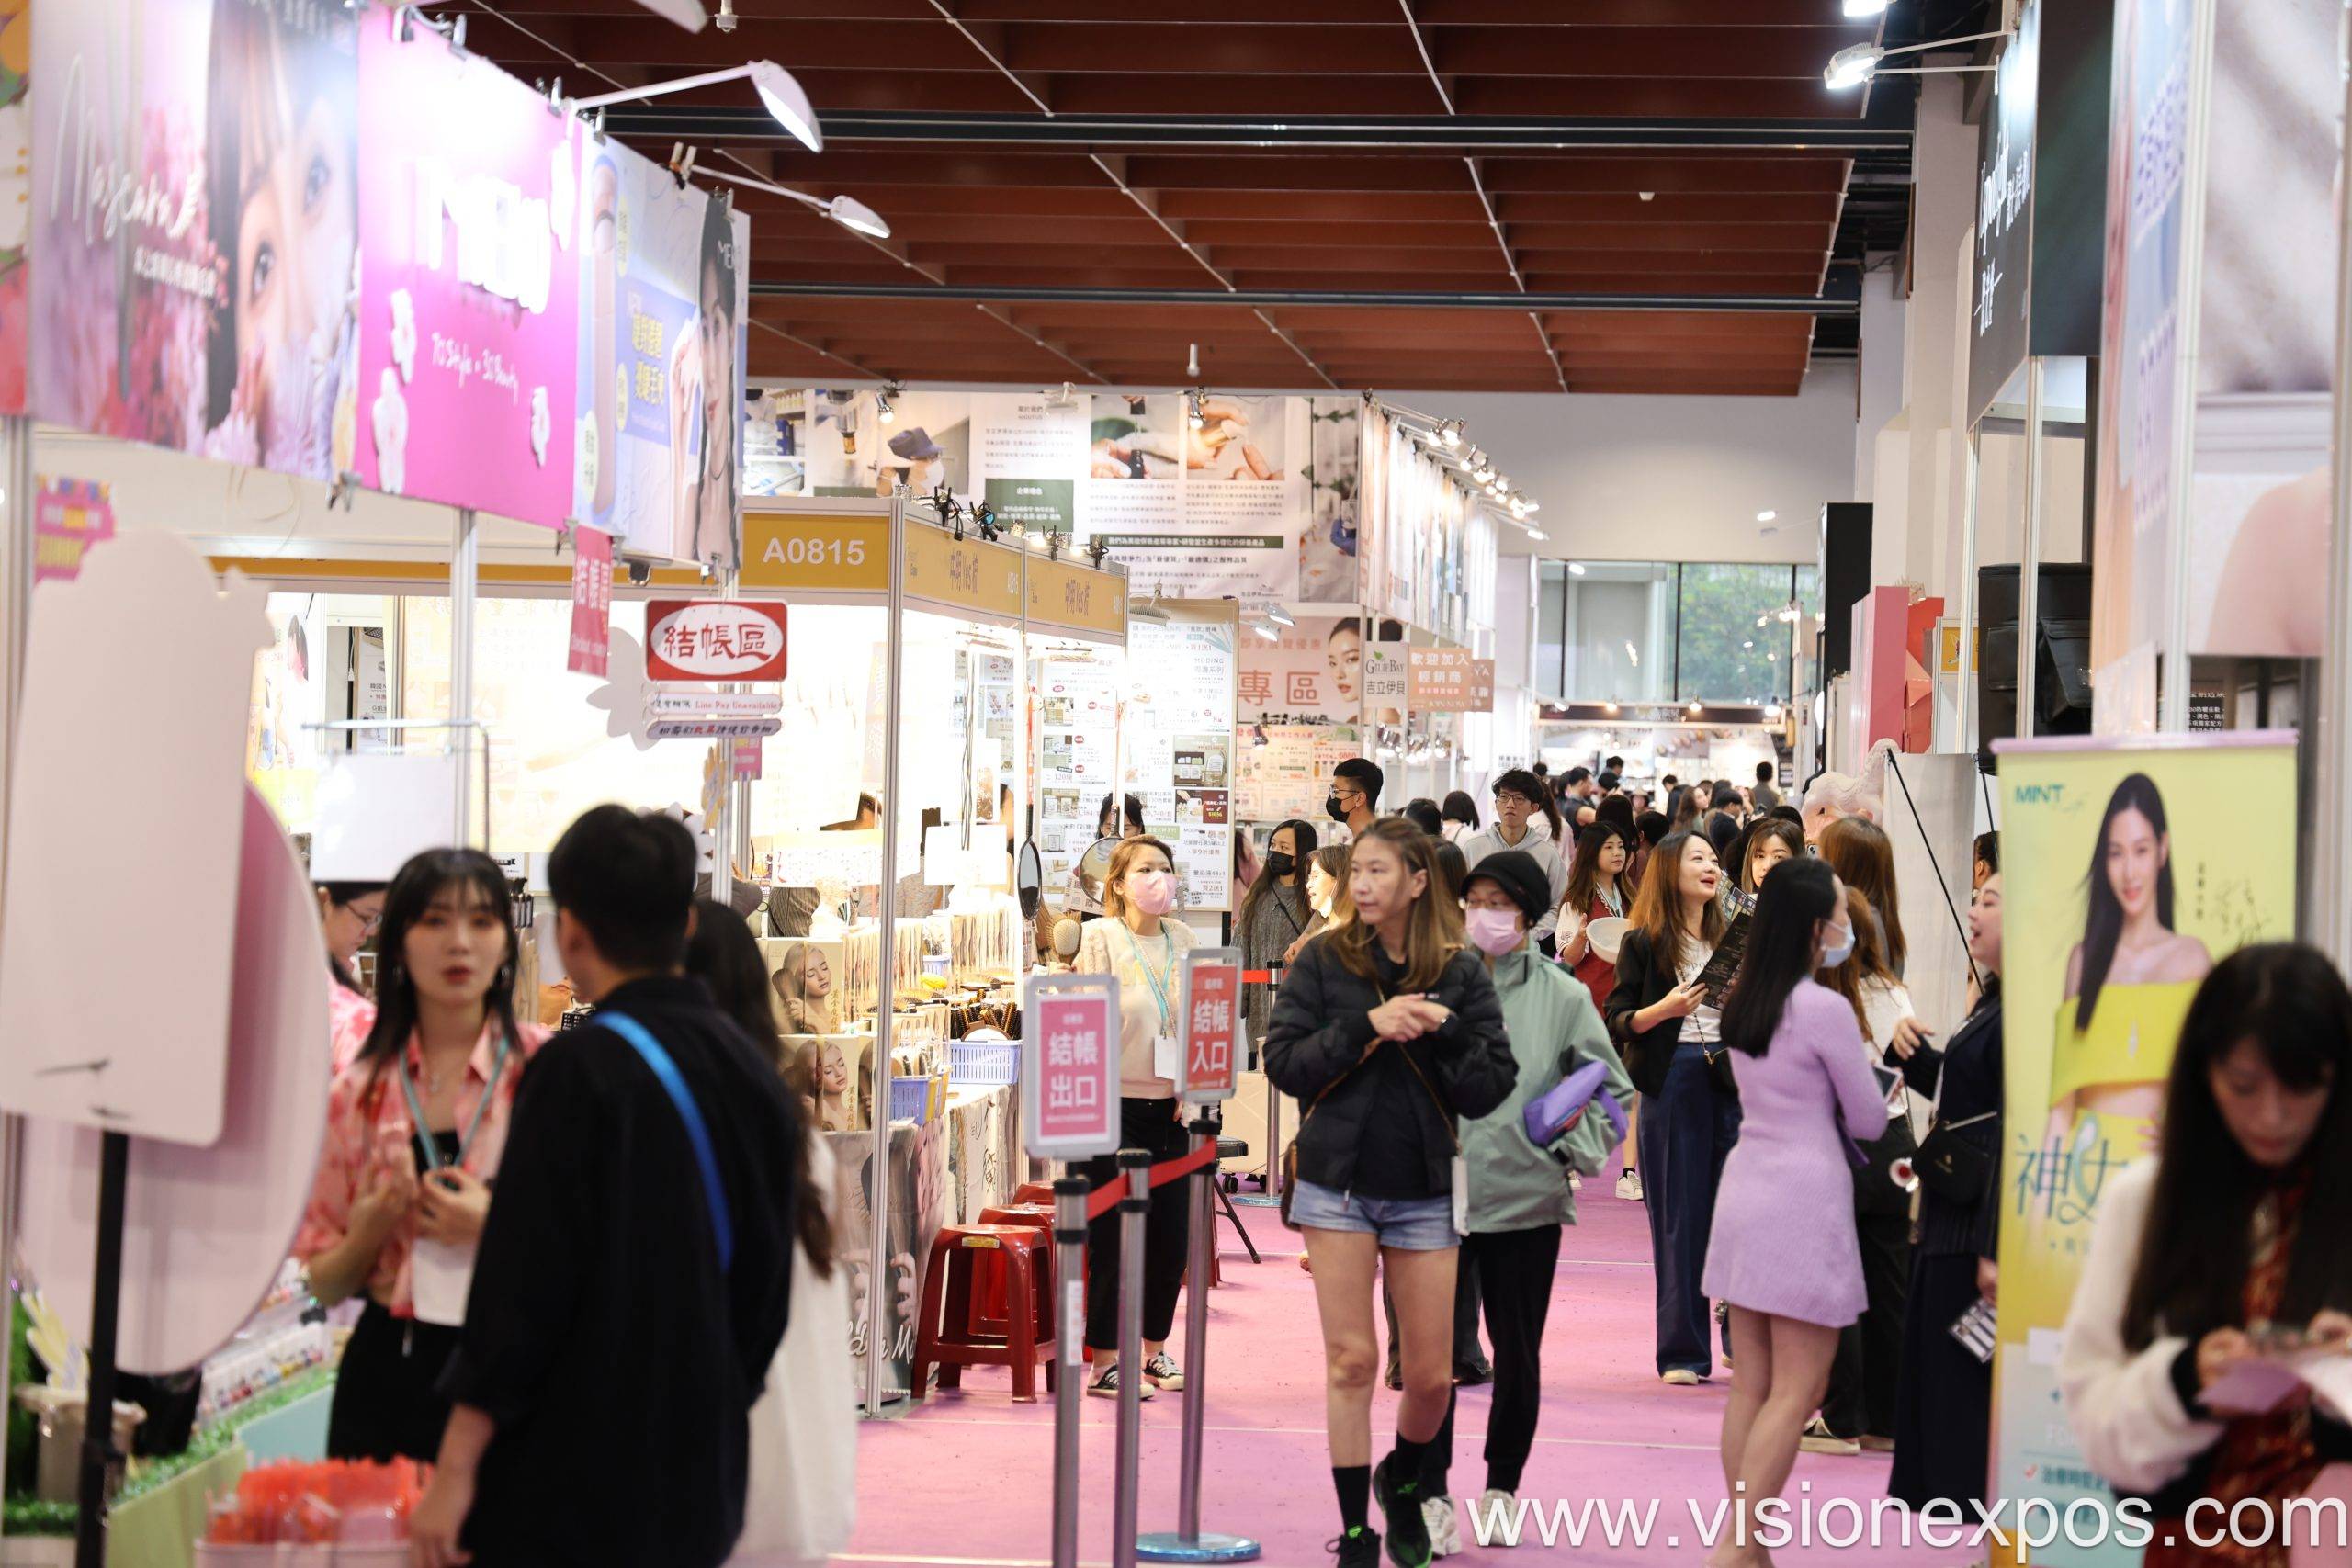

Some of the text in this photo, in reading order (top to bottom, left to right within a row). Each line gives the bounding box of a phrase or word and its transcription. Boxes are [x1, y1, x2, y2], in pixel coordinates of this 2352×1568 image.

[763, 537, 865, 566] A0815
[663, 622, 772, 662] 結帳區
[1411, 652, 1469, 665] 歡迎加入
[1238, 670, 1321, 705] 專區
[1365, 680, 1406, 695] 吉立伊貝
[1418, 671, 1462, 683] 經銷商
[695, 701, 712, 709] Line
[715, 701, 729, 710] Pay
[732, 701, 778, 709] Unavailable
[2014, 784, 2064, 805] MINT
[1193, 999, 1230, 1033] 結帳
[1048, 1030, 1099, 1066] 結帳
[1191, 1040, 1228, 1073] 入口
[1048, 1074, 1097, 1109] 出口
